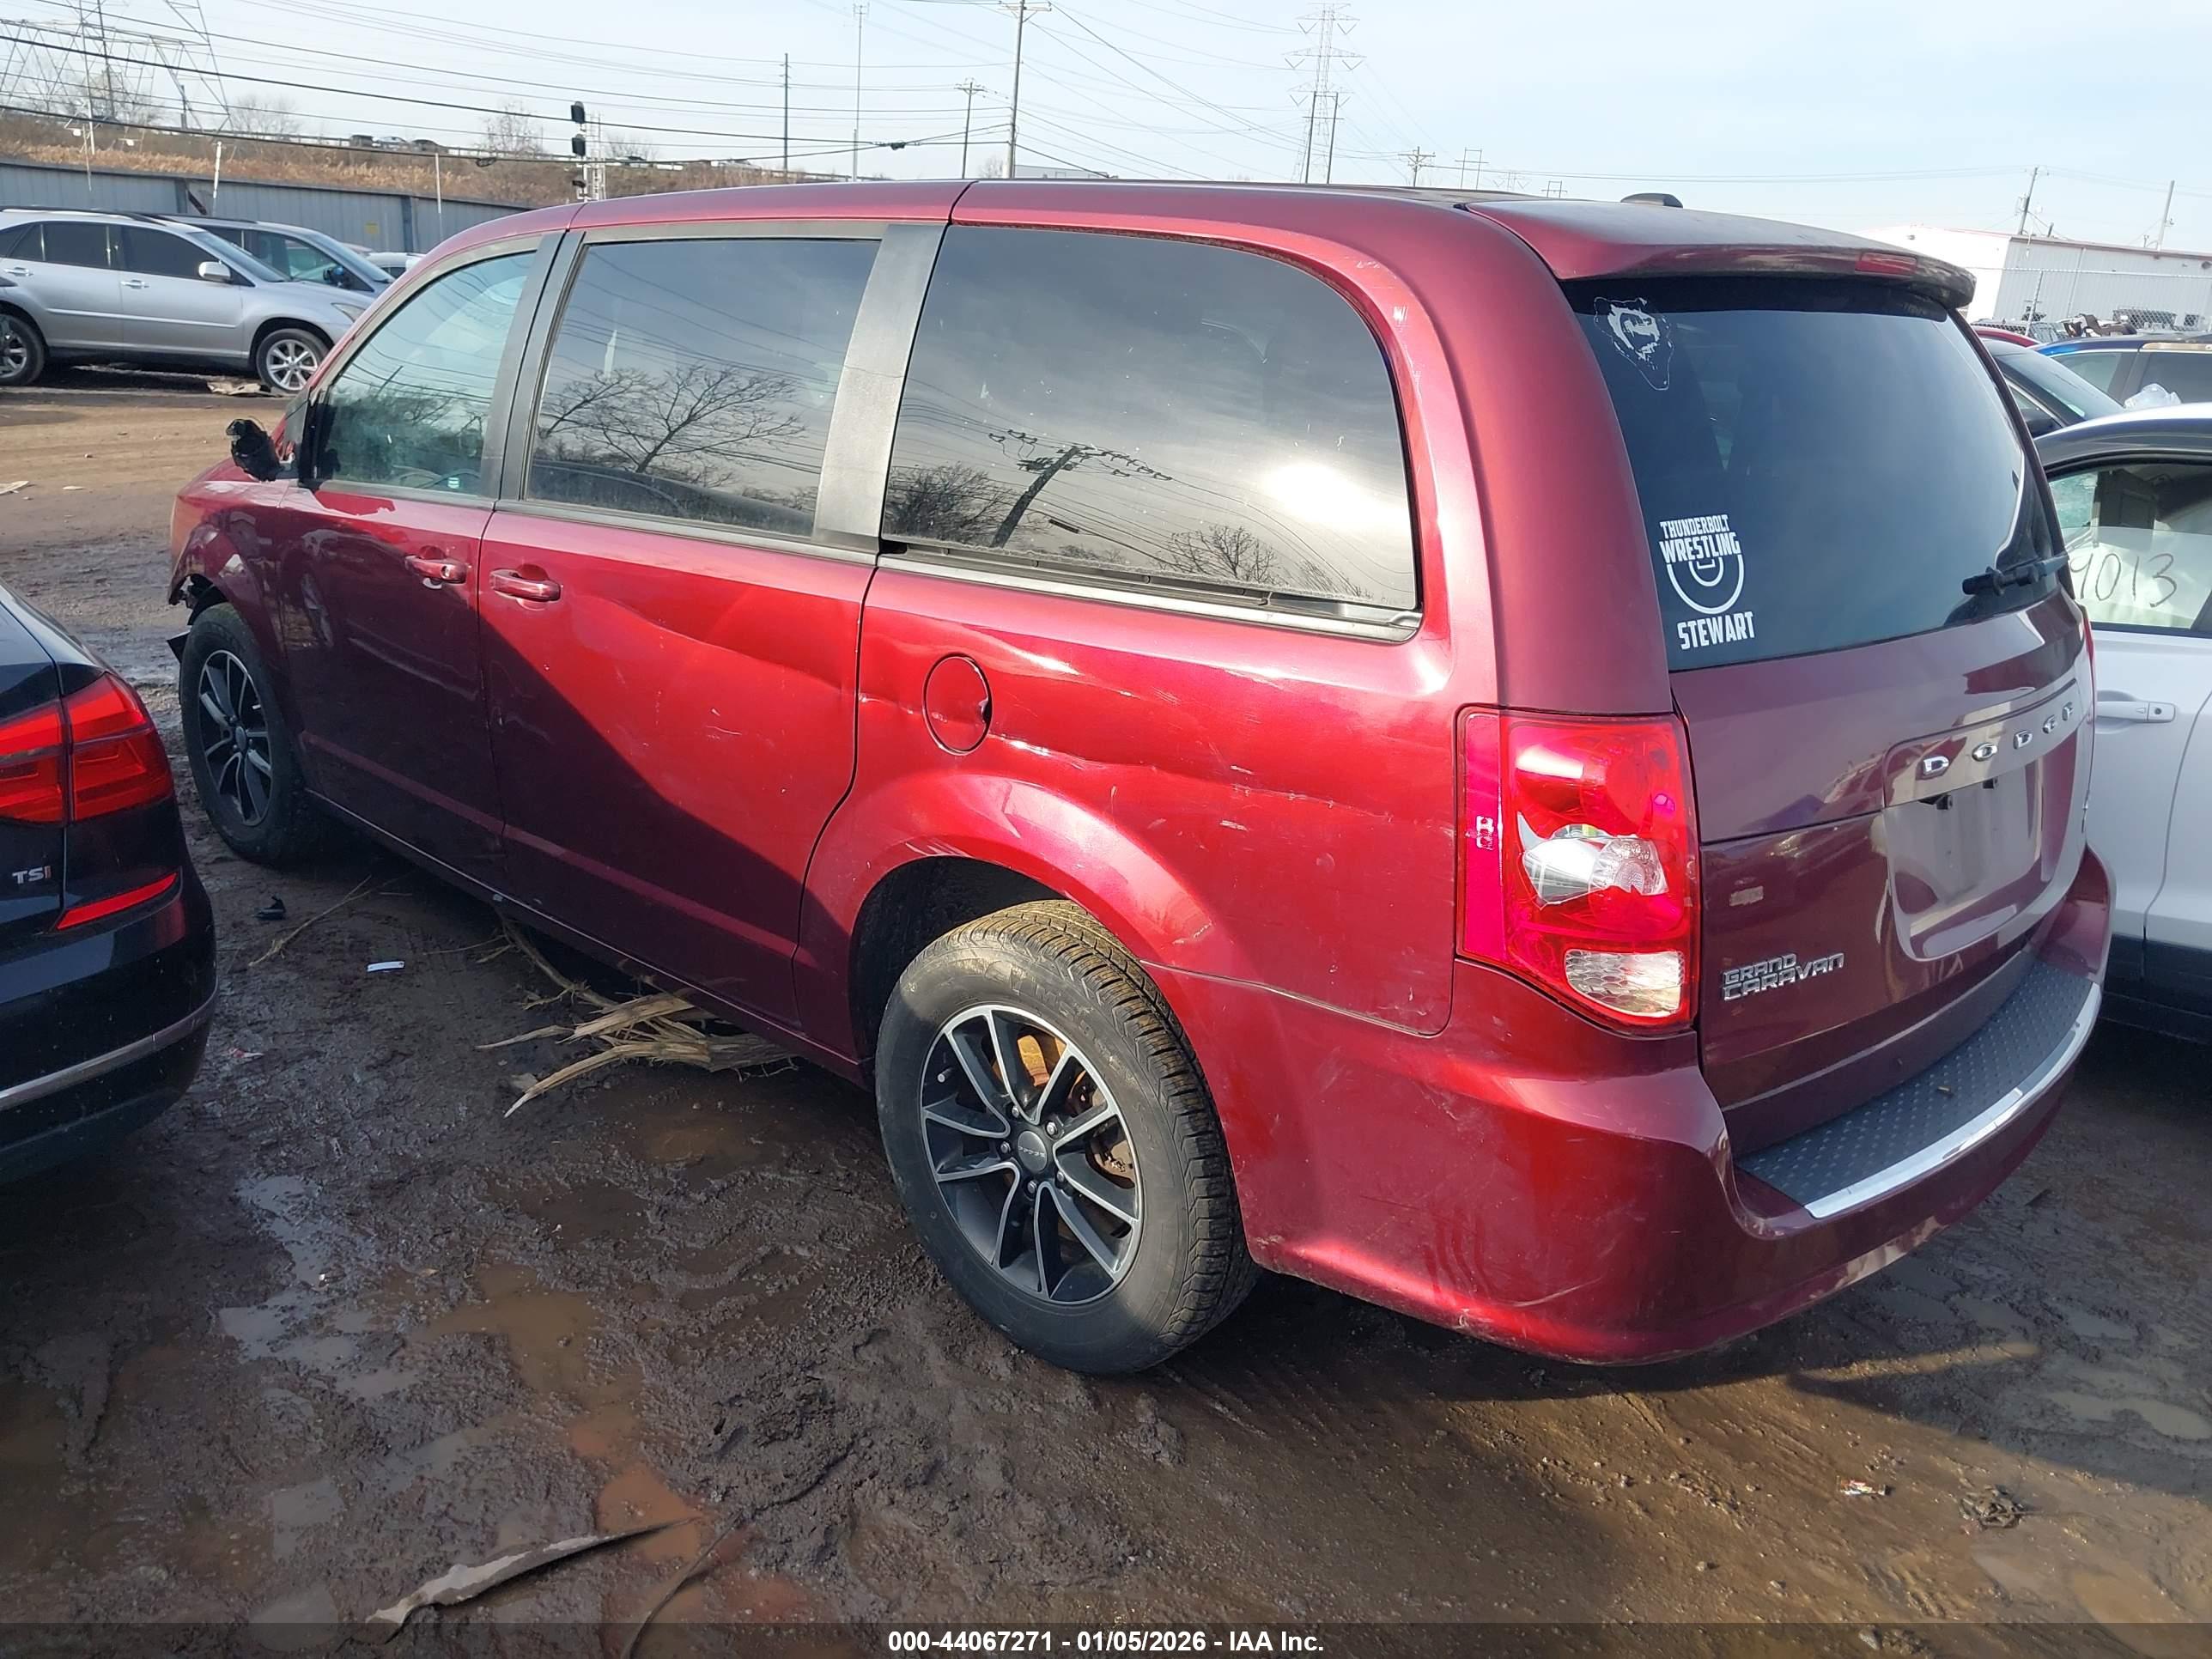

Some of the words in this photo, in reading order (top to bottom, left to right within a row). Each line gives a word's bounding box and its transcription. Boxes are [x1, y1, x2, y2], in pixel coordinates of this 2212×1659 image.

[1659, 514, 1730, 539] THUNDERBOLT
[1658, 532, 1741, 563] WRESTLING
[2069, 553, 2178, 608] 9013
[1677, 611, 1755, 650] STEWART
[1723, 953, 1797, 985] GRAND
[1723, 952, 1844, 1000] CARAVAN
